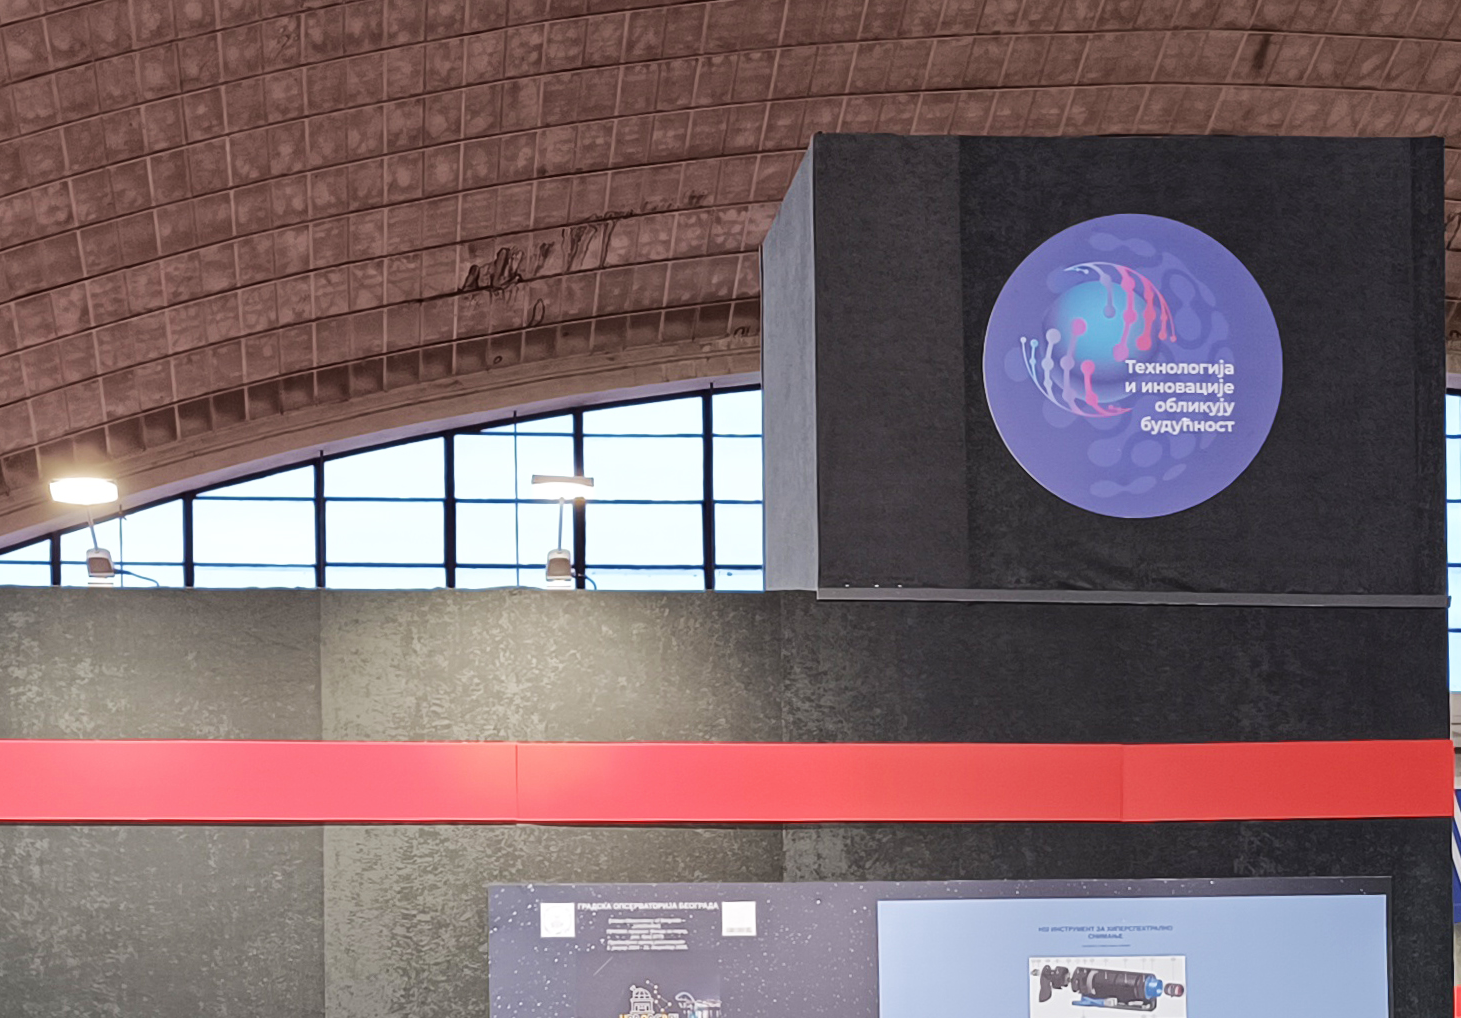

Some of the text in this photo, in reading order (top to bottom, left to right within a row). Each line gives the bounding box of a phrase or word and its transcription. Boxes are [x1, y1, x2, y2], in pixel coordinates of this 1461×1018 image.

[1125, 359, 1235, 378] Технологија
[1125, 379, 1235, 397] и иновације
[1154, 397, 1235, 416] обликују
[1140, 416, 1235, 435] будућност
